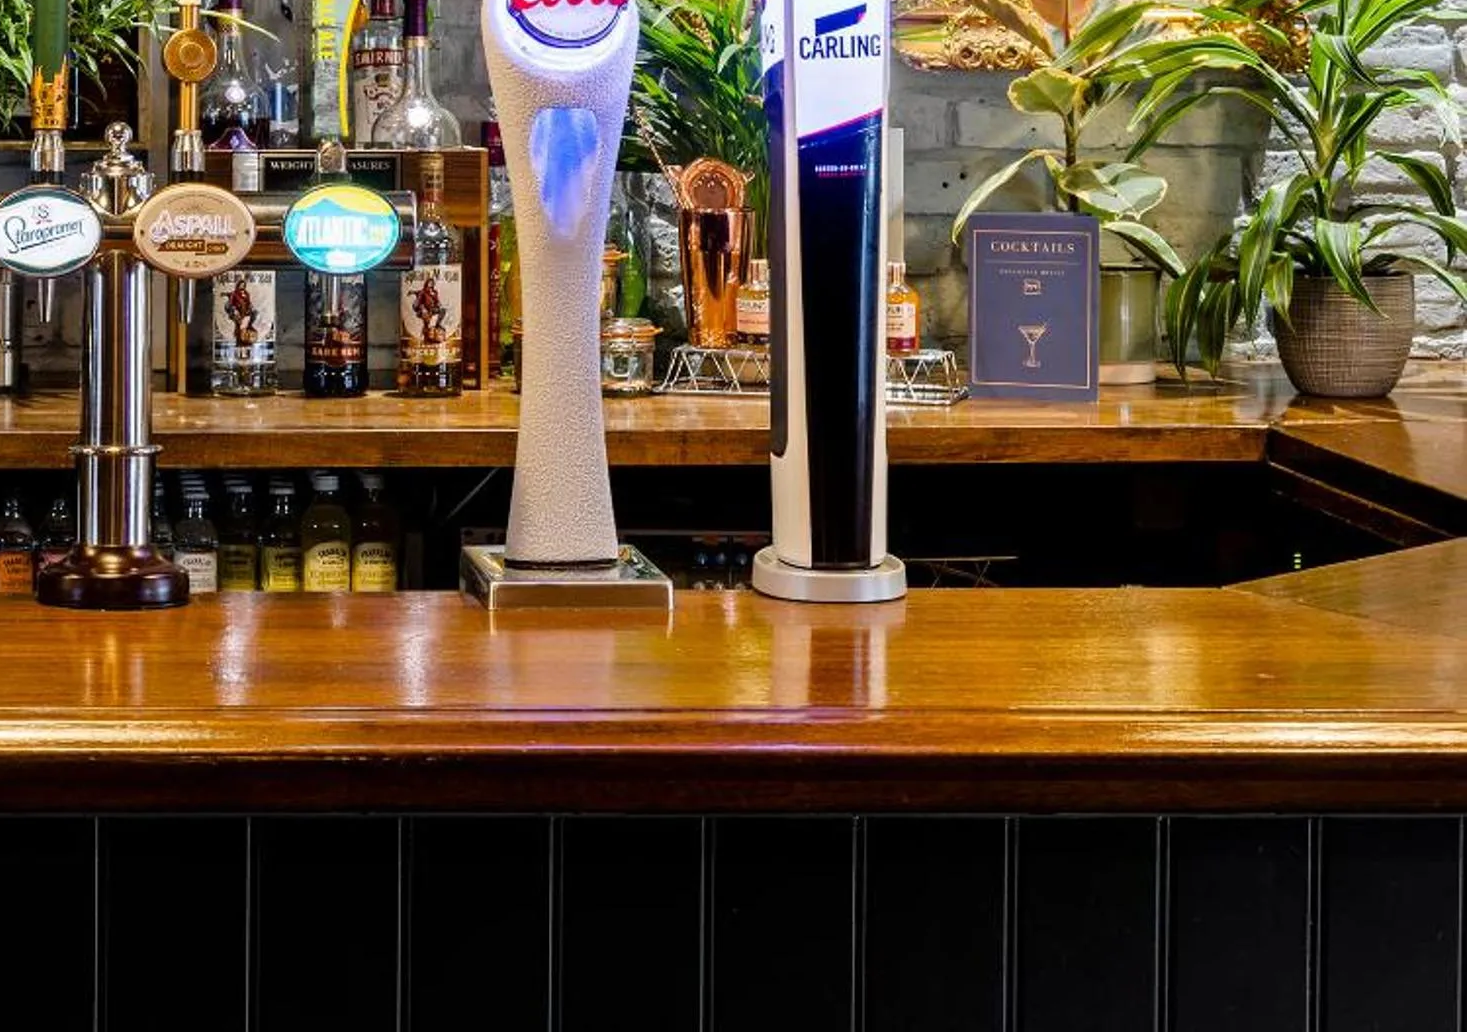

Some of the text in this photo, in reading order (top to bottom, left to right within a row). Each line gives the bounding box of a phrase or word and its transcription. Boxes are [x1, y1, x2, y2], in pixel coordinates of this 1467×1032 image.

[799, 34, 881, 60] CARLING
[355, 51, 402, 64] SMIRNO
[150, 210, 236, 242] ASPALL
[991, 241, 1075, 254] COCKTAILS
